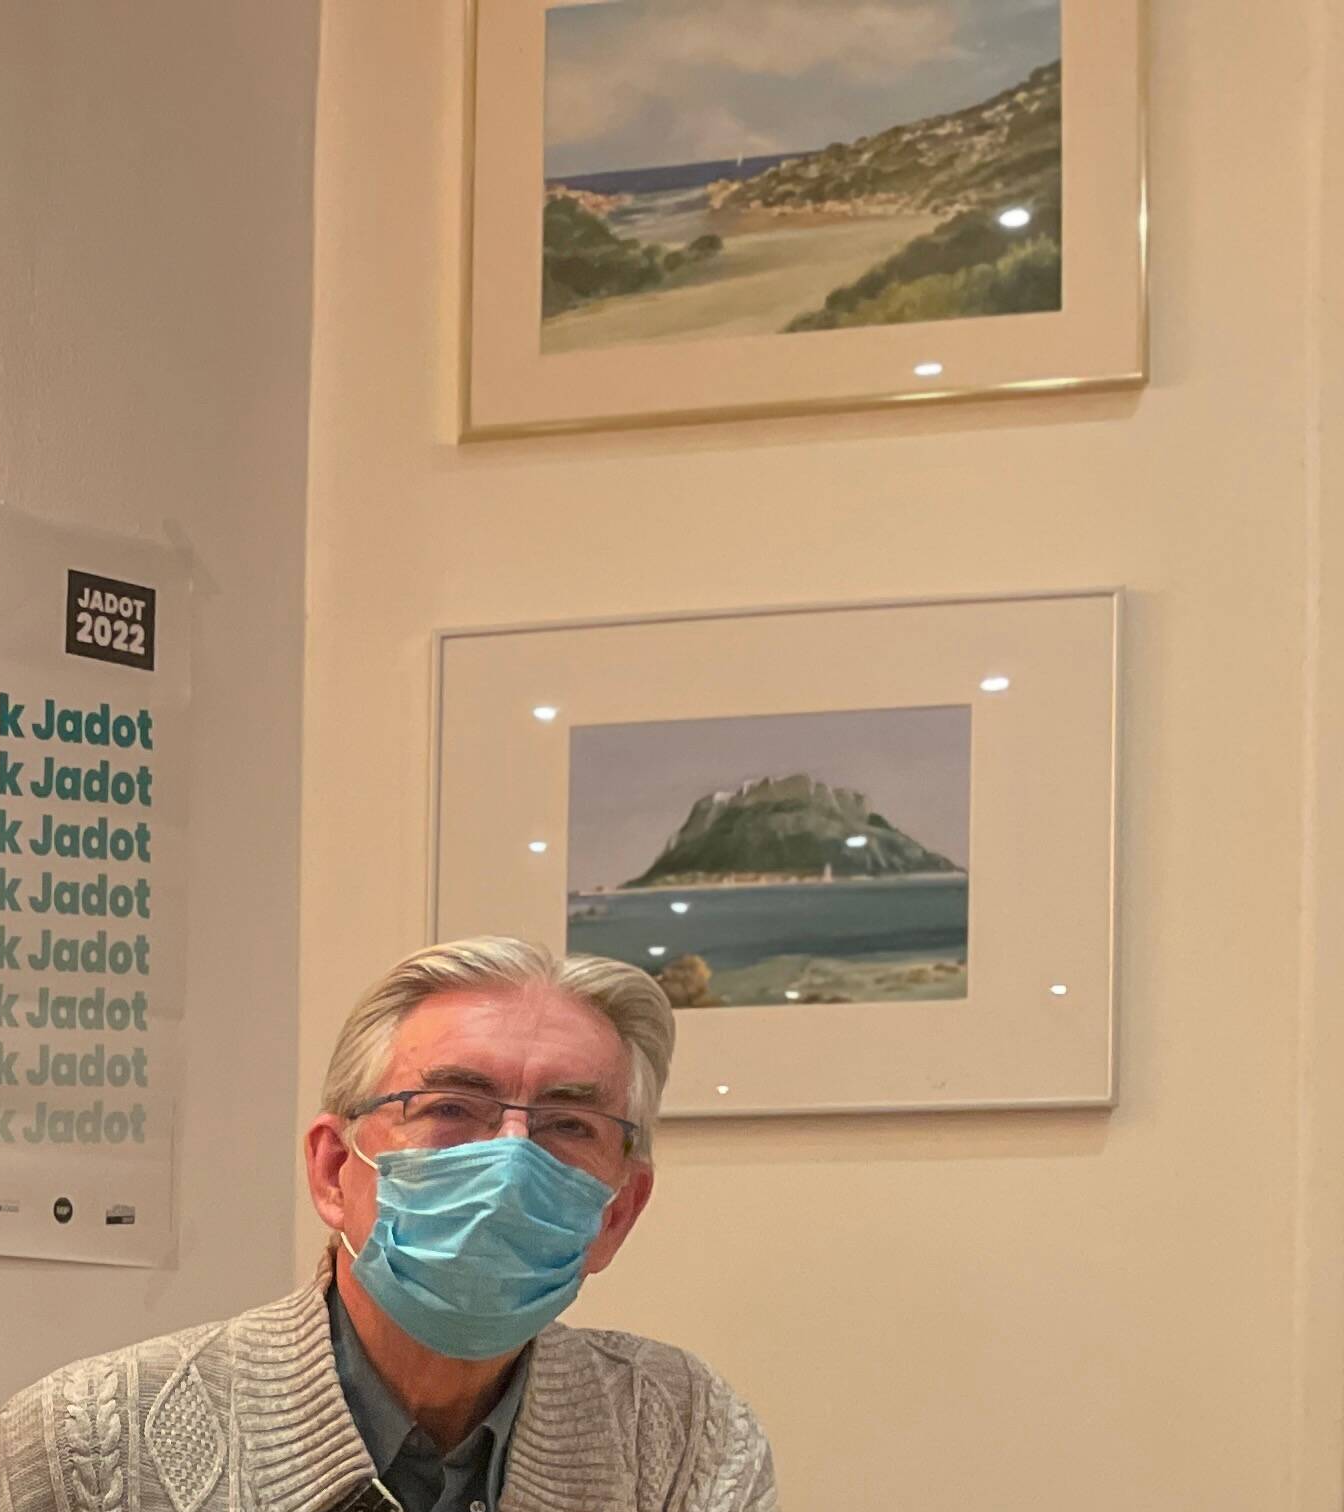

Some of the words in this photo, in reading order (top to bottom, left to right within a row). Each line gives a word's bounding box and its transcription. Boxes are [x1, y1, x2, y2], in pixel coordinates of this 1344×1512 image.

[77, 587, 146, 621] JADOT
[76, 612, 145, 655] 2022
[31, 699, 153, 750] Jadot
[30, 757, 152, 808] Jadot
[29, 814, 151, 864] Jadot
[28, 871, 150, 919] Jadot
[27, 930, 150, 975] Jadot
[25, 987, 148, 1031] Jadot
[25, 1043, 148, 1088] Jadot
[22, 1100, 147, 1145] Jadot
